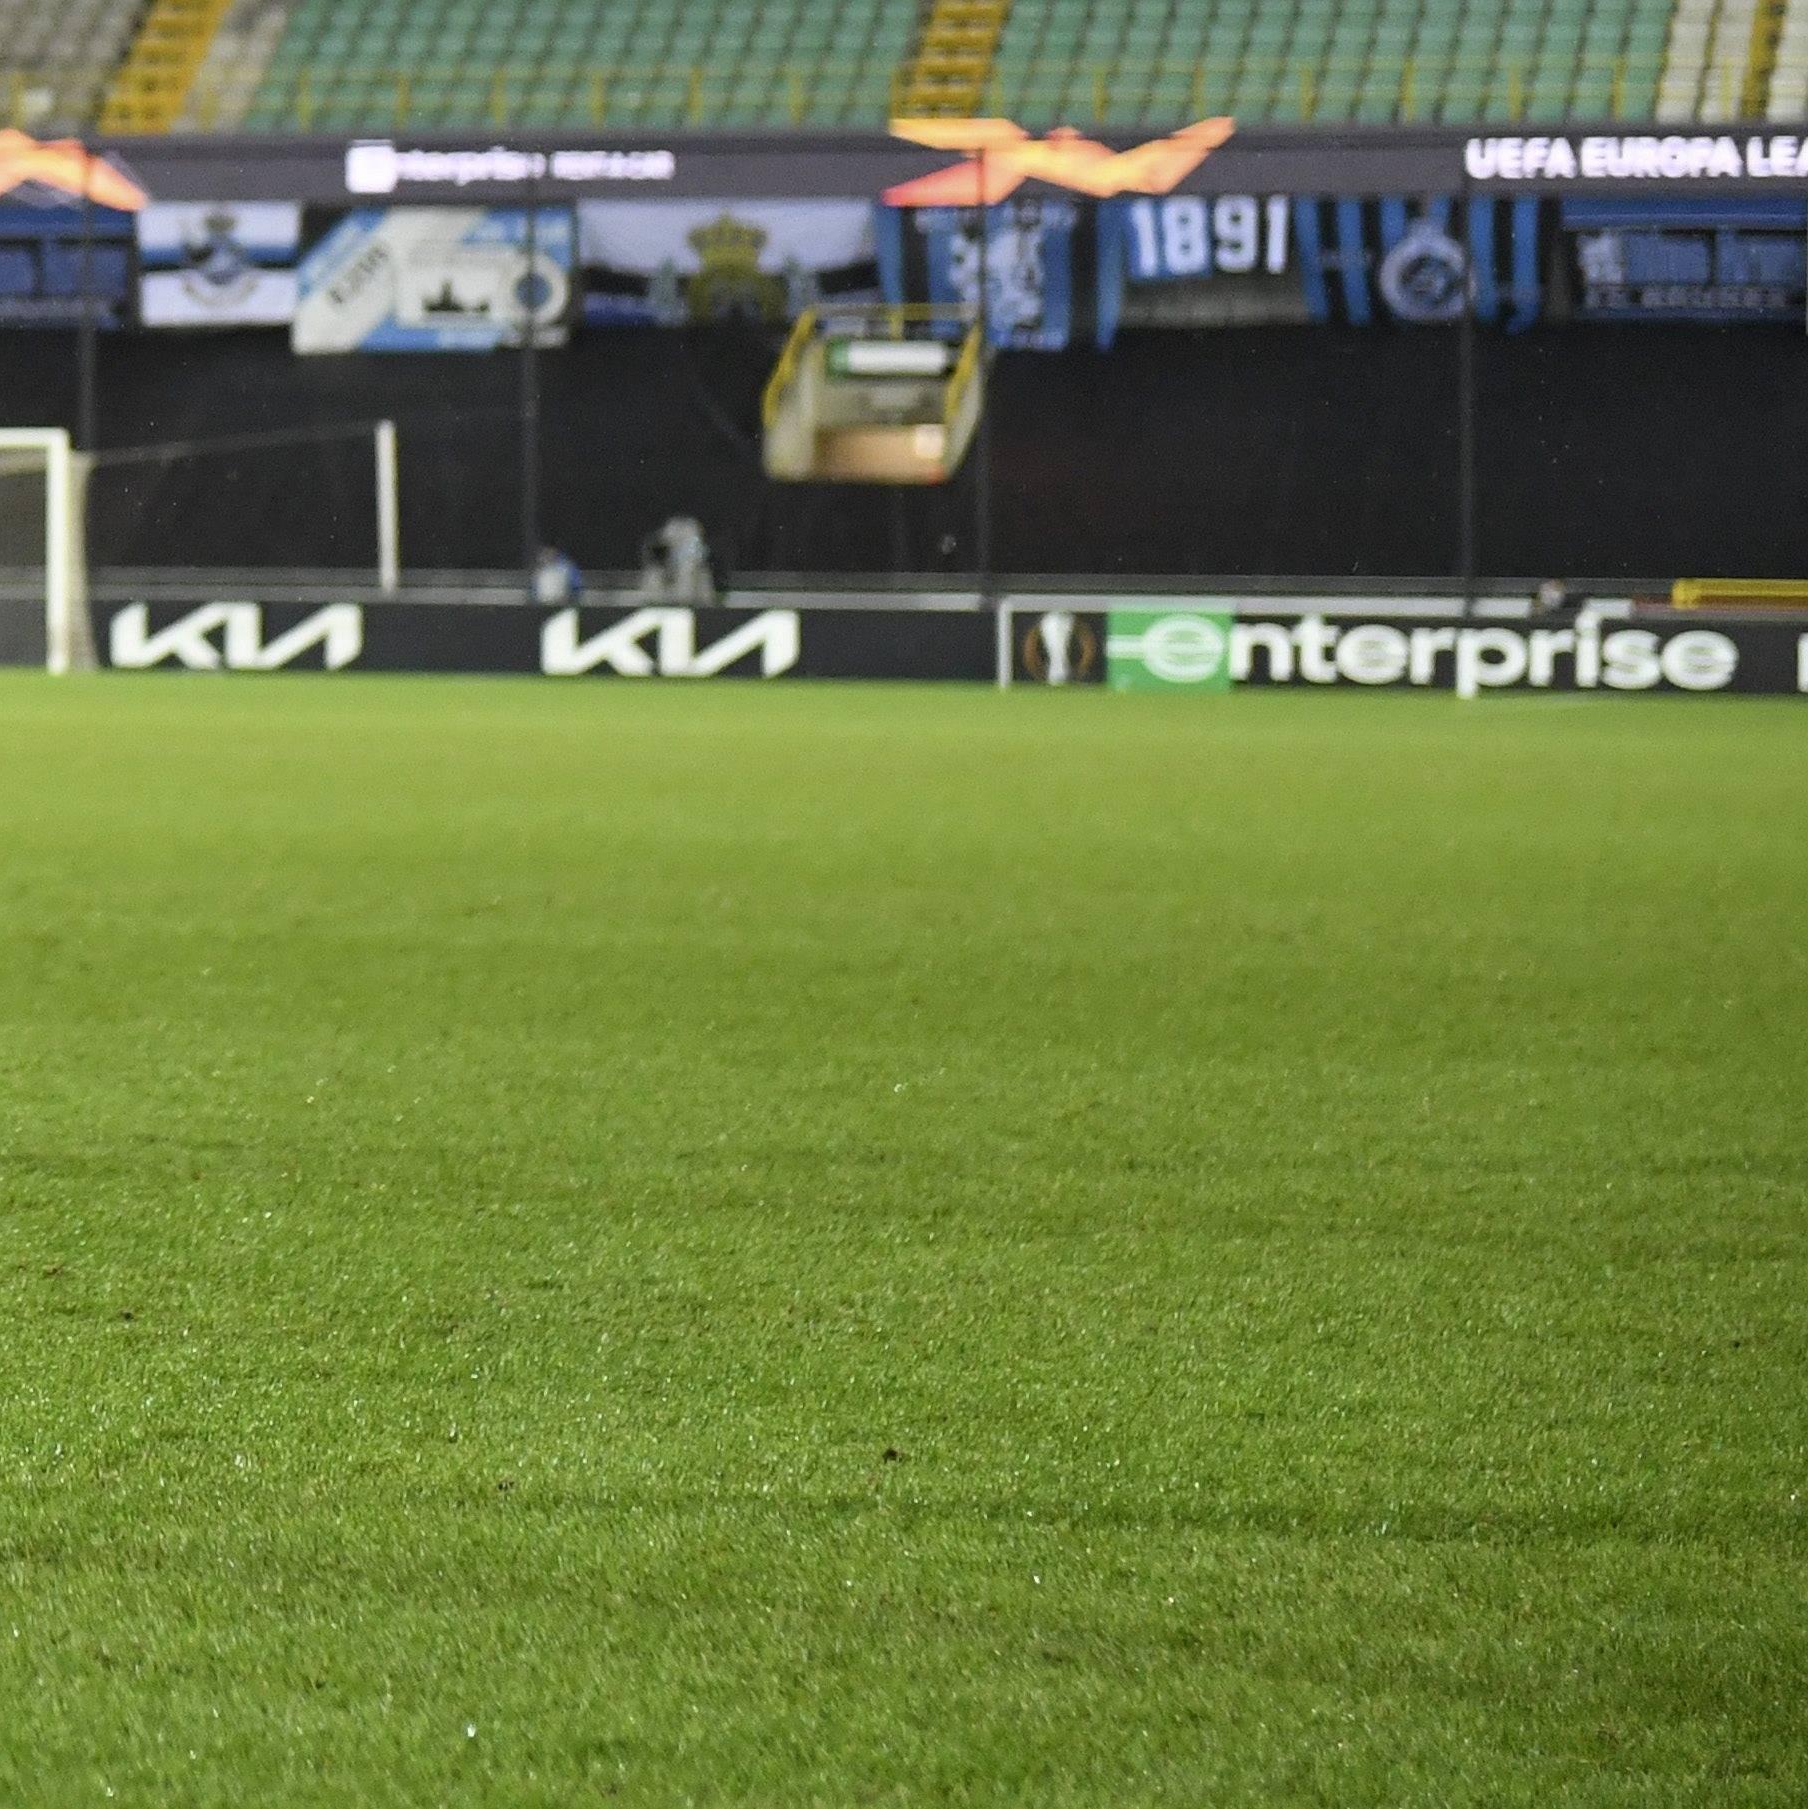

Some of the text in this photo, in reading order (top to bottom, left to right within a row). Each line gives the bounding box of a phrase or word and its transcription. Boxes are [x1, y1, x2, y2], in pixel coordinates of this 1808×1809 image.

[1466, 137, 1578, 180] UEFA
[1580, 136, 1743, 179] EUROPA
[1131, 194, 1290, 276] 1891
[110, 601, 365, 671] KIA
[540, 607, 802, 678] KIA
[1141, 610, 1740, 698] enterprise
